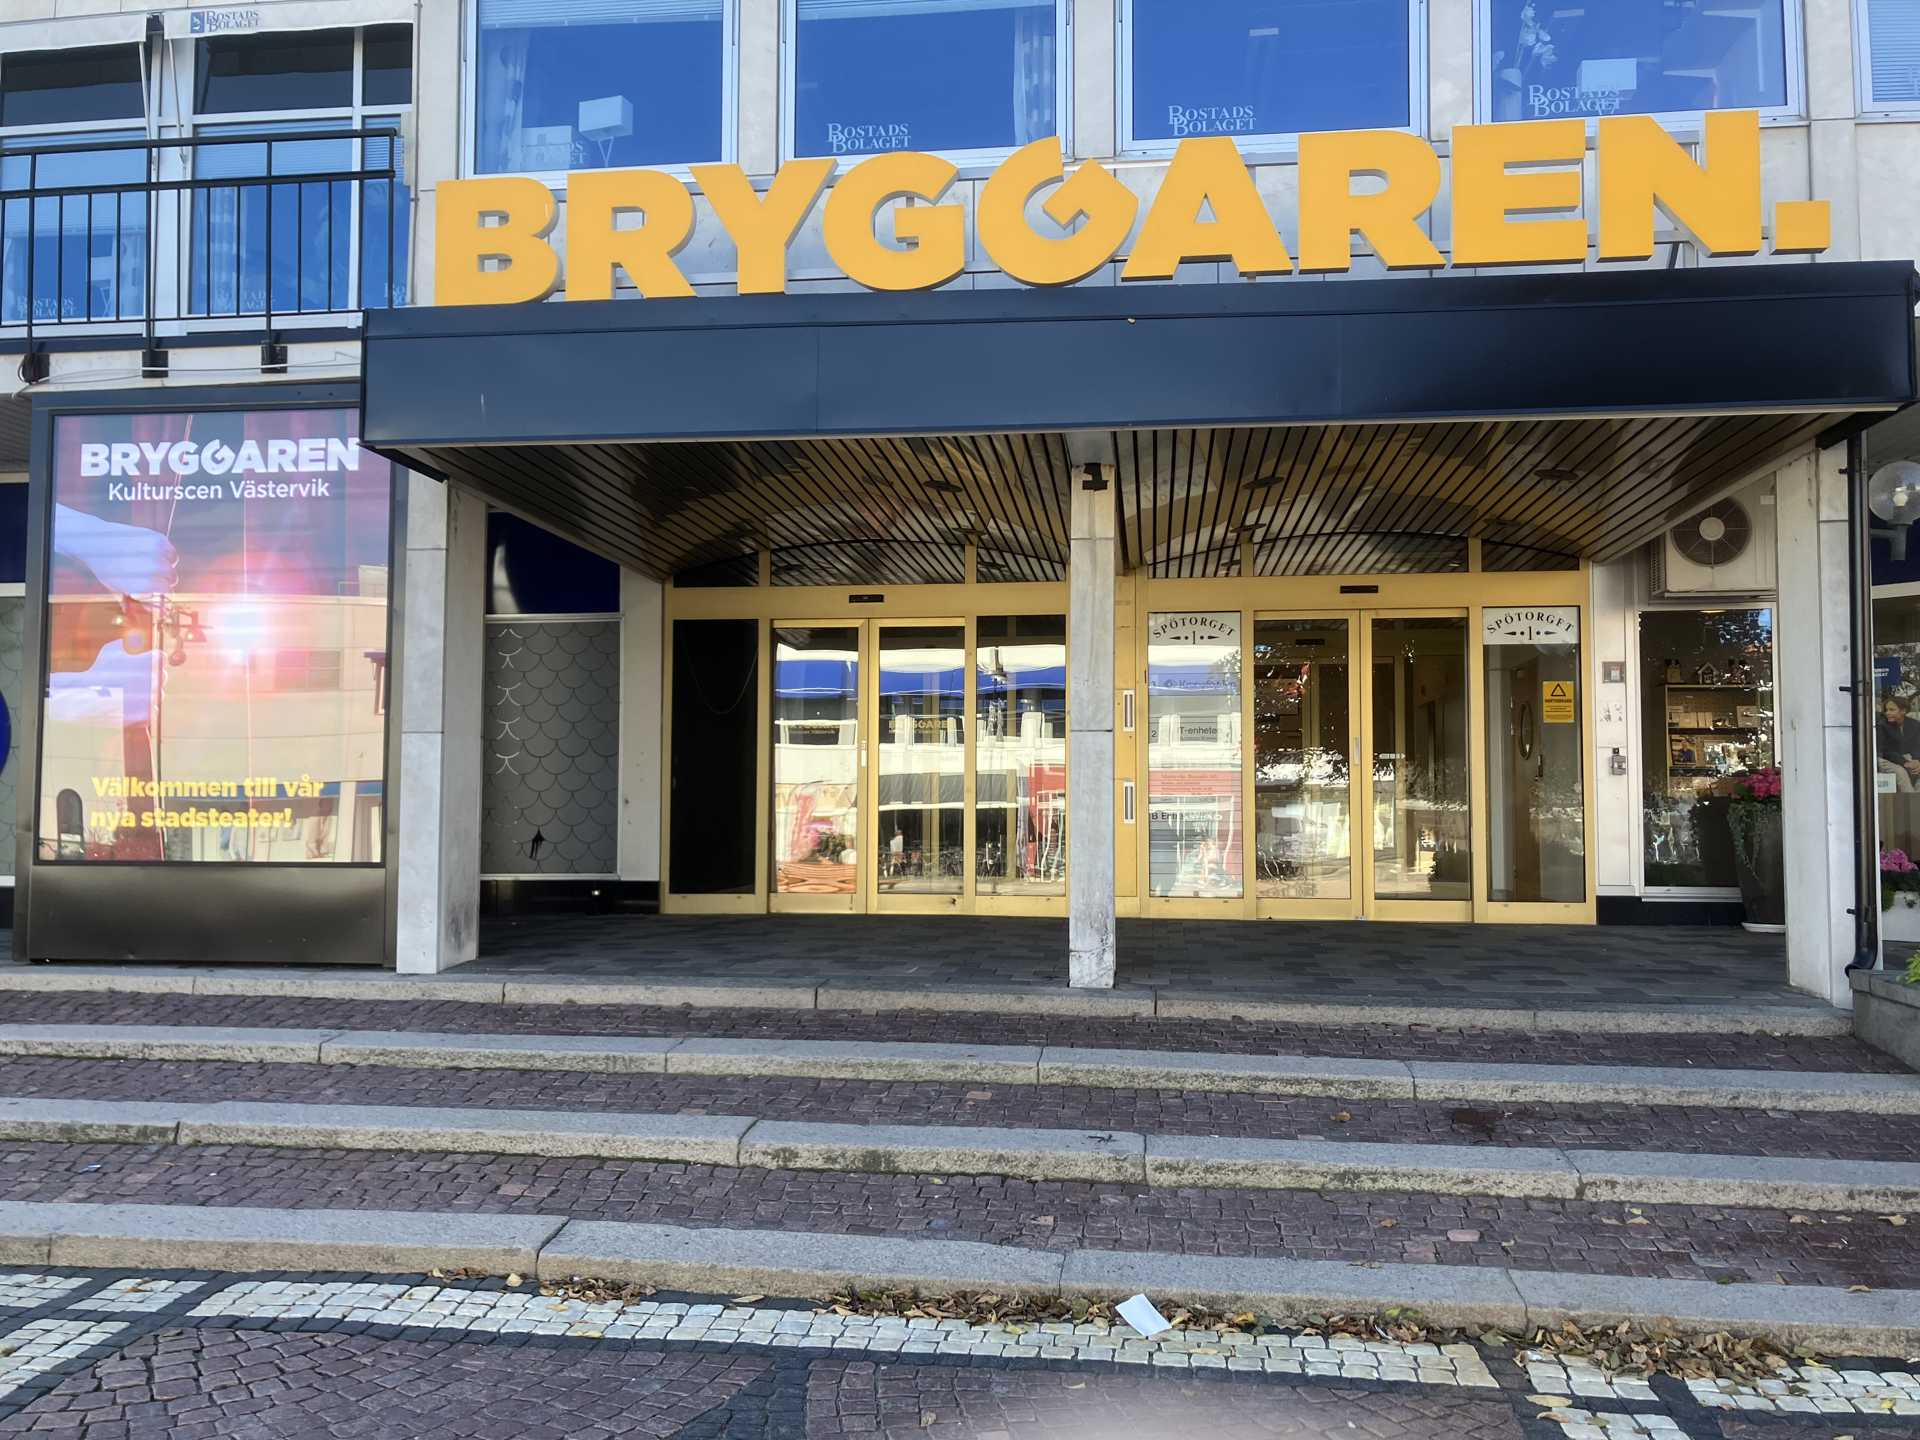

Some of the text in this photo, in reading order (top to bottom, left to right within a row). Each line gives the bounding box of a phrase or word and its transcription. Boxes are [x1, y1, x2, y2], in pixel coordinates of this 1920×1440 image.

[206, 10, 259, 24] BOSTADS
[208, 18, 259, 32] BOLAGET
[1528, 84, 1620, 105] BOSTADS
[1168, 105, 1254, 125] BOSTADS
[827, 123, 909, 142] BOSTADS
[1173, 117, 1256, 136] BOLAGET
[832, 134, 911, 153] BOLAGET
[80, 437, 359, 477] BRYGGAREN
[108, 478, 330, 501] Kulturscen Västervik
[1152, 616, 1235, 639] SPÖTORGET
[1486, 611, 1574, 634] SPÖTORGET
[92, 773, 324, 798] Välkommen till vår
[90, 807, 292, 831] nya stadsteater!
